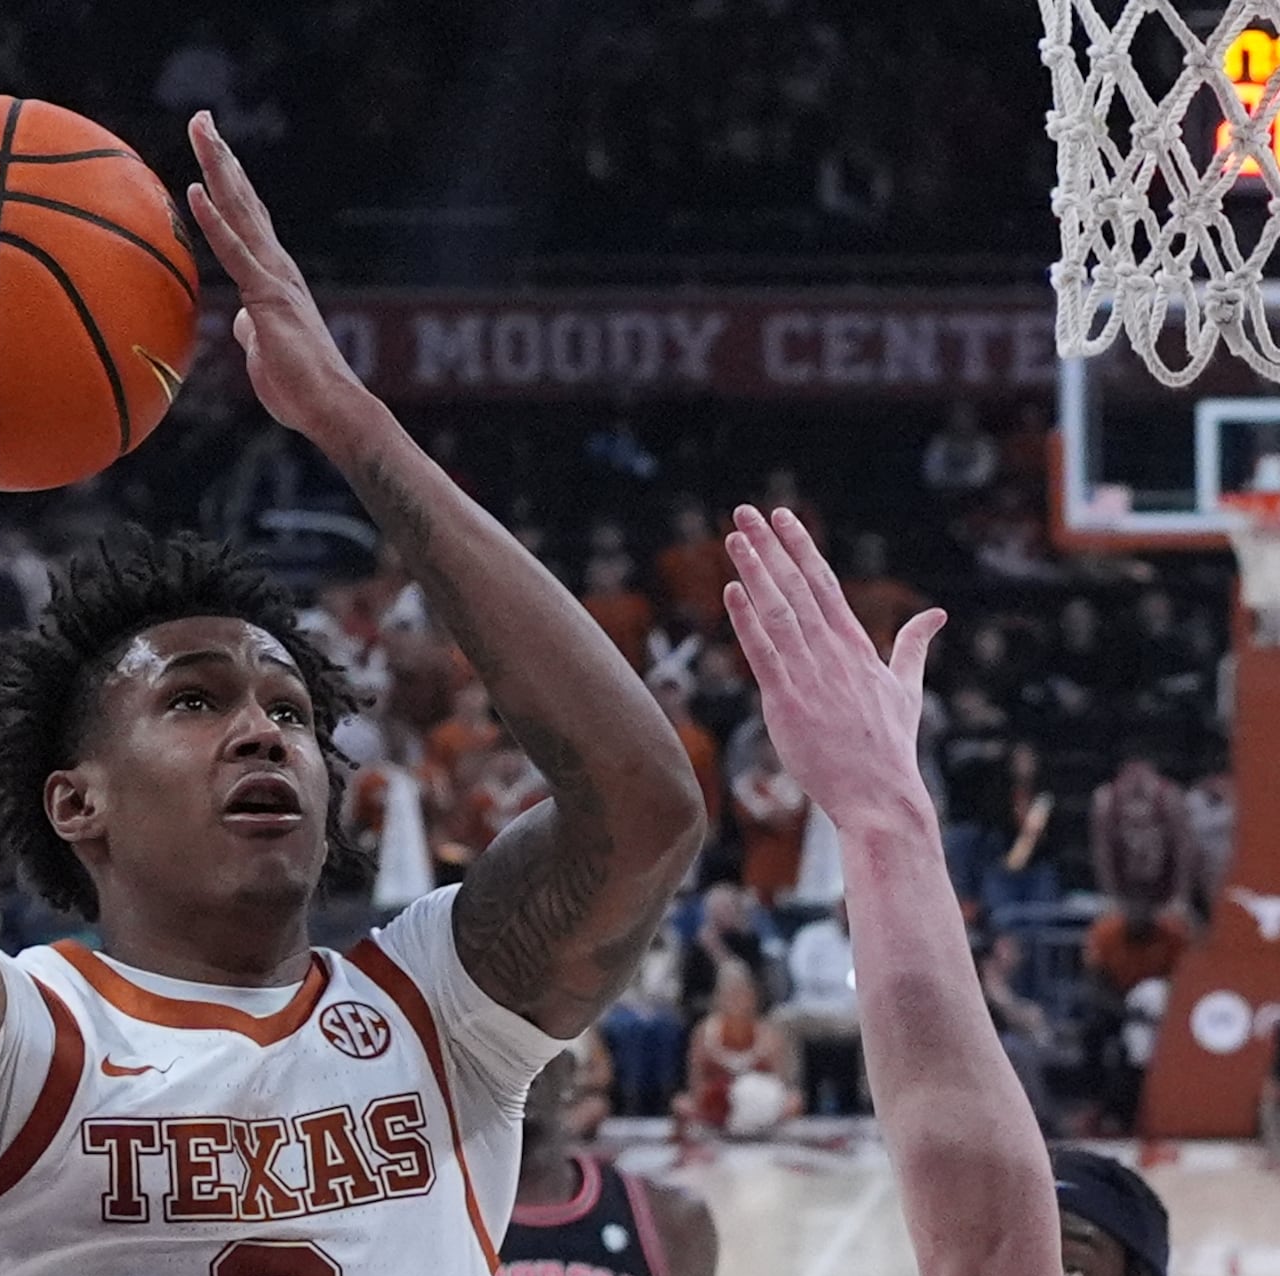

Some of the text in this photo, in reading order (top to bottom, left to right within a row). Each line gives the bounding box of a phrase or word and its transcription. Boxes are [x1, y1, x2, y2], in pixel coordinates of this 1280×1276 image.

[413, 312, 728, 382] MOODY
[760, 312, 1060, 383] CENTE
[320, 1001, 391, 1059] SEC
[81, 1092, 437, 1224] TEXAS
